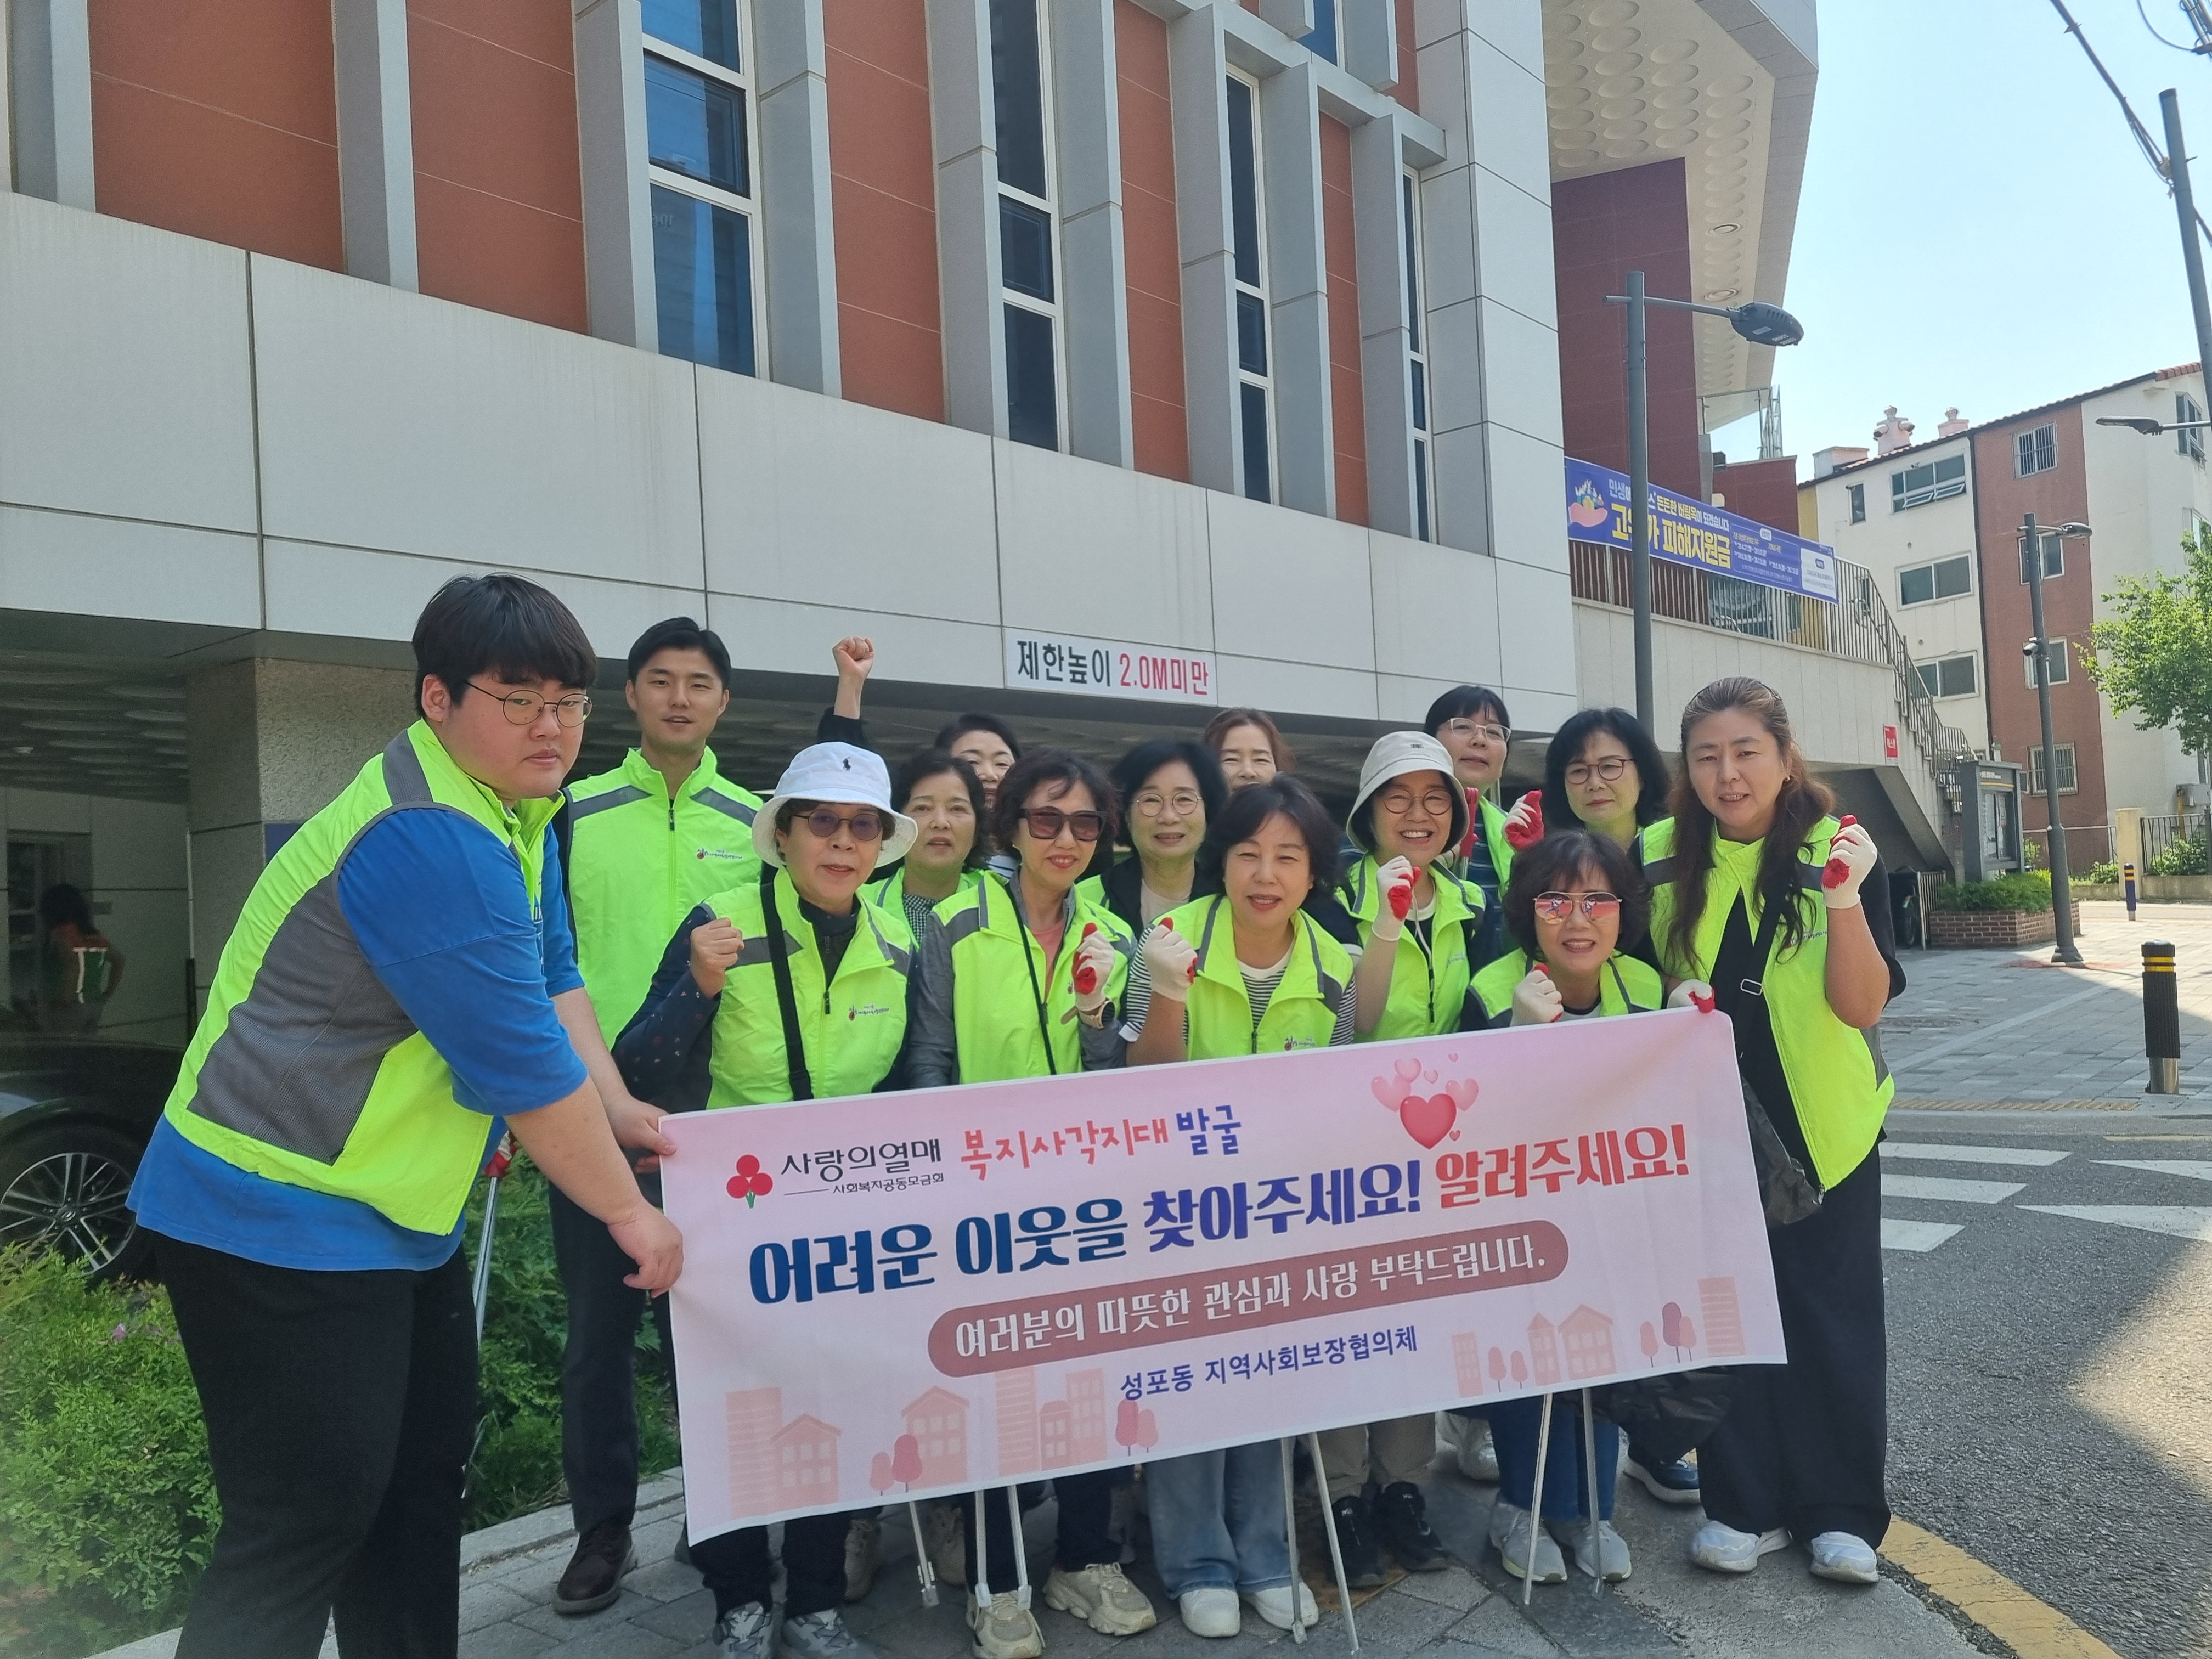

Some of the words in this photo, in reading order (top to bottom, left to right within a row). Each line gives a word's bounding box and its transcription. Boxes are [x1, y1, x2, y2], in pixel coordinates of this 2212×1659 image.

[1611, 503, 1660, 550] 고가
[1662, 518, 1730, 569] 피해지원금
[1657, 495, 1677, 516] 든든한
[1017, 640, 1111, 687] 제한높이
[1119, 653, 1209, 696] 2.0M미만
[781, 1138, 943, 1182] 사랑의열매
[960, 1118, 1169, 1181] 복지사각지대
[1176, 1104, 1242, 1156] 발굴
[749, 1224, 937, 1305] 어려운
[955, 1198, 1128, 1275] 이웃을
[1143, 1159, 1421, 1254] 찾아주세요!
[1435, 1123, 1690, 1209] 알려주세요!
[833, 1172, 945, 1195] 사회복지공동모금회
[956, 1304, 1085, 1358] 여러분의
[1098, 1288, 1190, 1335] 따뜻한
[1203, 1272, 1291, 1321] 관심과
[1302, 1263, 1358, 1302] 사랑
[1370, 1234, 1546, 1292] 부탁드립니다.
[1120, 1364, 1194, 1401] 성포동
[1205, 1325, 1417, 1386] 지역사회보장협의체
